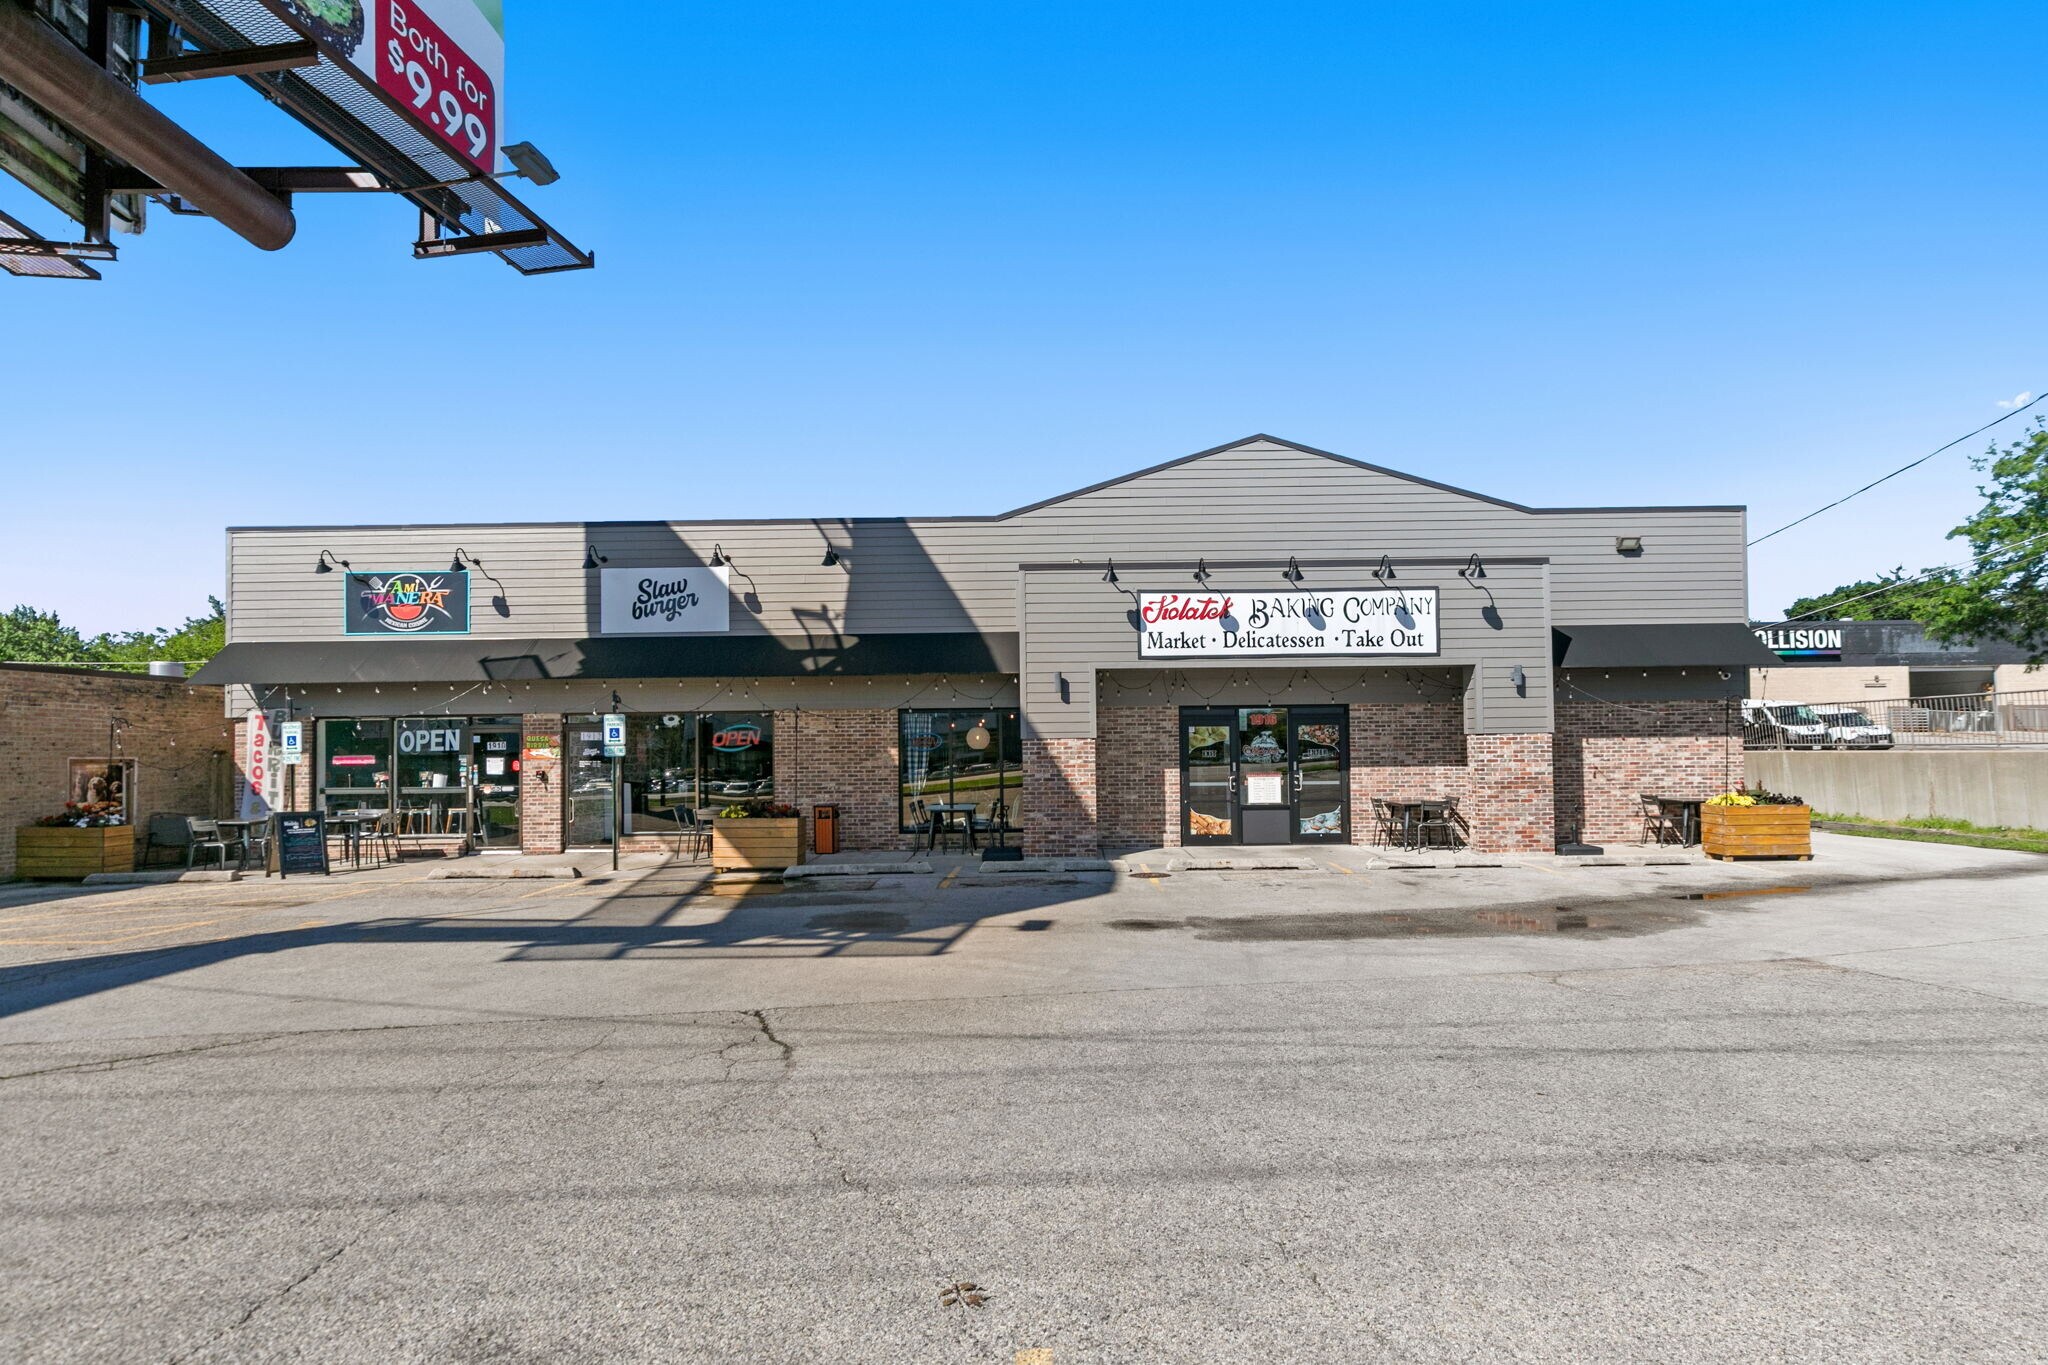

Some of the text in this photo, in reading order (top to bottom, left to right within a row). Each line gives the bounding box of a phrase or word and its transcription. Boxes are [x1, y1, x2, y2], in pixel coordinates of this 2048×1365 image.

[390, 0, 488, 111] Both for
[387, 38, 488, 158] $9.99
[637, 578, 688, 605] Slaw
[631, 592, 699, 622] burger
[1147, 628, 1425, 649] Market Delicatessen Take Out
[400, 729, 460, 752] OPEN
[712, 729, 761, 748] OPEN
